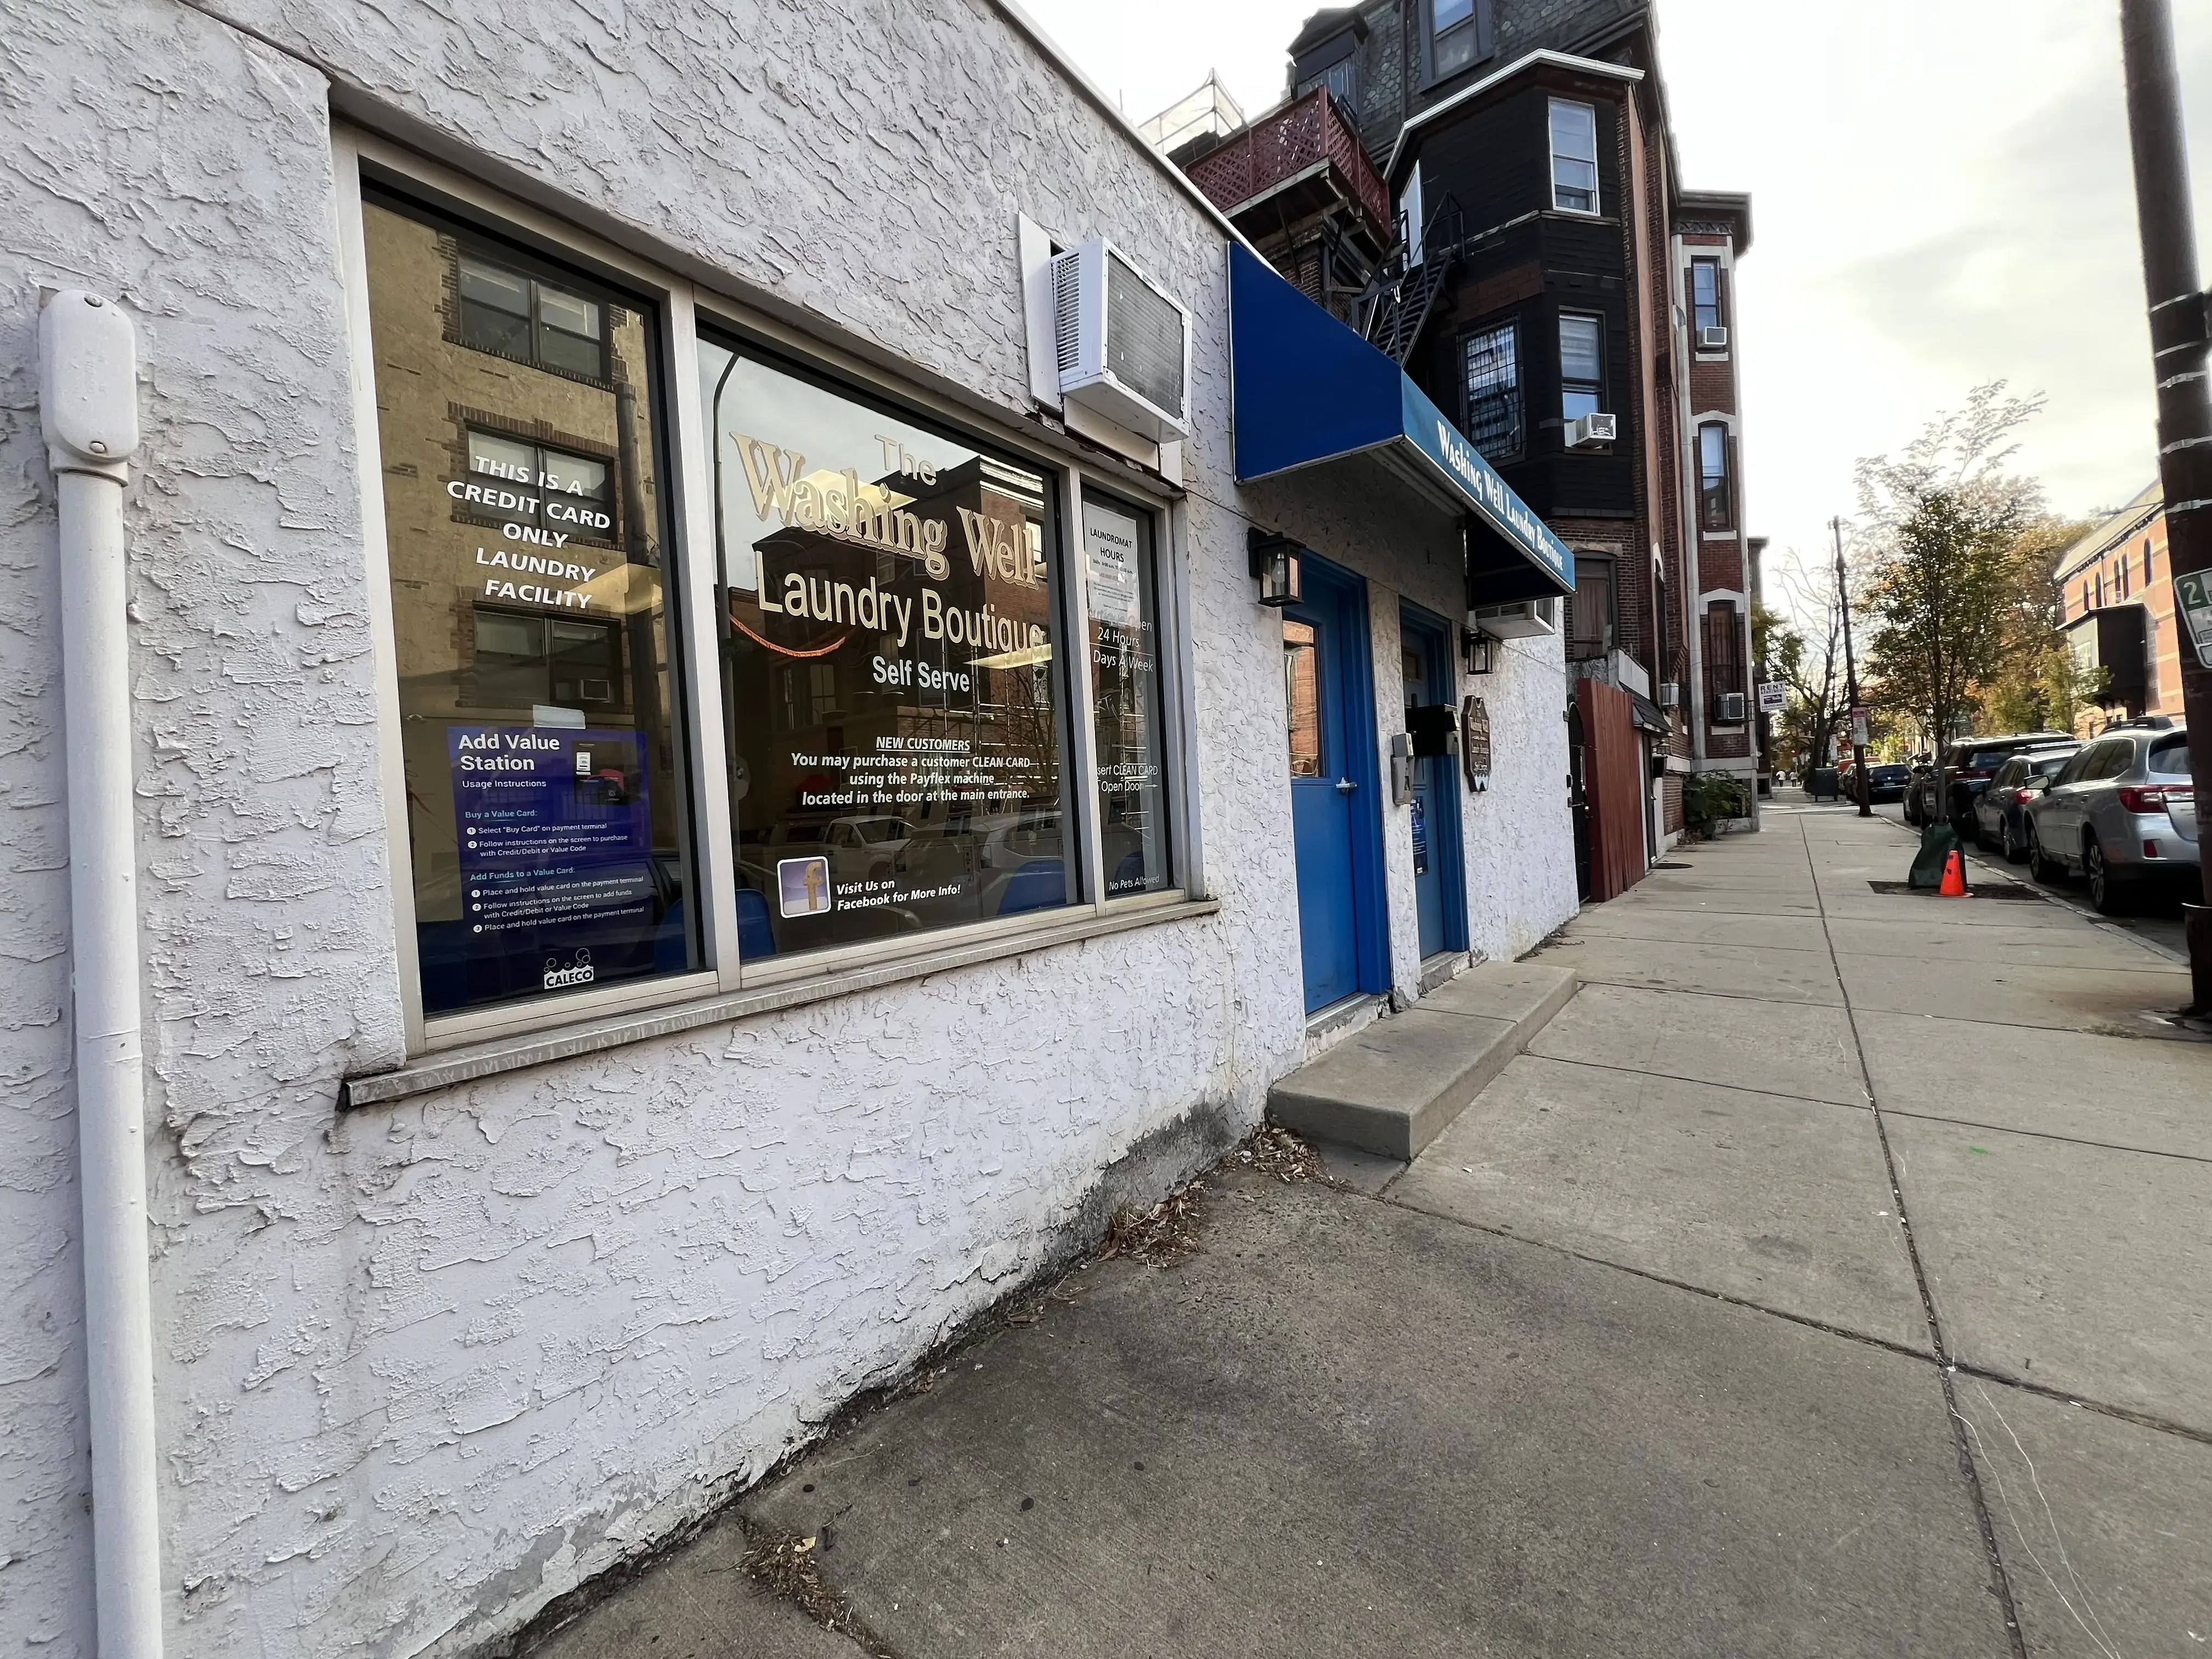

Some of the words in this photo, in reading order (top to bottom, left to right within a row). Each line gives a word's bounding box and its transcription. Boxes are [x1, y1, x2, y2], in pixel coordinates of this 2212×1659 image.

[874, 435, 937, 486] The
[475, 456, 529, 483] THIS
[538, 471, 559, 490] IS
[566, 480, 583, 496] A
[447, 481, 540, 514] CREDIT
[546, 503, 610, 529] CARD
[729, 431, 950, 581] Washing
[956, 505, 1039, 590] Well
[503, 523, 568, 548] ONLY
[1090, 527, 1132, 549] LAUNDROMAT
[1100, 547, 1124, 563] HOURS
[476, 548, 596, 582] LAUNDRY
[484, 579, 593, 609] FACILITY
[2183, 582, 2201, 605] 2
[755, 551, 911, 647] Laundry
[922, 588, 1045, 655] Boutique
[1098, 627, 1109, 641] 24
[1113, 630, 1139, 647] Hours
[1093, 650, 1116, 668] Days
[1119, 656, 1126, 668] A
[1129, 656, 1153, 672] Week
[873, 656, 911, 685] Self
[917, 662, 970, 692] Serve
[459, 733, 499, 749] Add
[505, 734, 560, 750] Value
[876, 736, 904, 749] NEW
[907, 738, 970, 751] CUSTOMERS
[460, 754, 534, 770] Station
[791, 753, 817, 766] You
[821, 754, 850, 769] may
[853, 755, 907, 769] purchase
[911, 758, 918, 768] a
[921, 757, 969, 768] customer
[973, 757, 1003, 768] CLEAN
[1006, 757, 1030, 768] CARD
[1097, 765, 1111, 775] sert
[1114, 765, 1136, 775] CLEAN
[1138, 765, 1158, 775] CARD
[462, 780, 492, 789] Usage
[849, 774, 884, 787] using
[887, 772, 907, 785] the
[910, 772, 951, 787] Payflex
[953, 773, 995, 784] machine
[1102, 781, 1122, 794] Open
[1125, 781, 1143, 791] Door
[803, 791, 853, 805] located
[857, 792, 868, 803] in
[872, 791, 892, 803] the
[896, 790, 923, 802] door
[926, 791, 938, 801] at
[940, 789, 957, 801] the
[961, 789, 985, 800] main
[988, 789, 1030, 799] entrance.
[470, 873, 487, 881] Add
[489, 871, 514, 879] Funds
[592, 879, 618, 887] payment
[1109, 881, 1118, 891] No
[1120, 879, 1133, 890] Pets
[1135, 873, 1159, 887] Allowed
[803, 861, 823, 911] f
[837, 882, 862, 895] Visit
[866, 881, 878, 892] Us
[881, 879, 895, 890] on
[837, 895, 890, 911] Facebook
[893, 891, 909, 903] for
[911, 888, 936, 900] More
[939, 884, 961, 896] Info!
[501, 907, 544, 917] Credit/Debit
[594, 910, 619, 919] payment
[546, 970, 592, 987] CALECO
